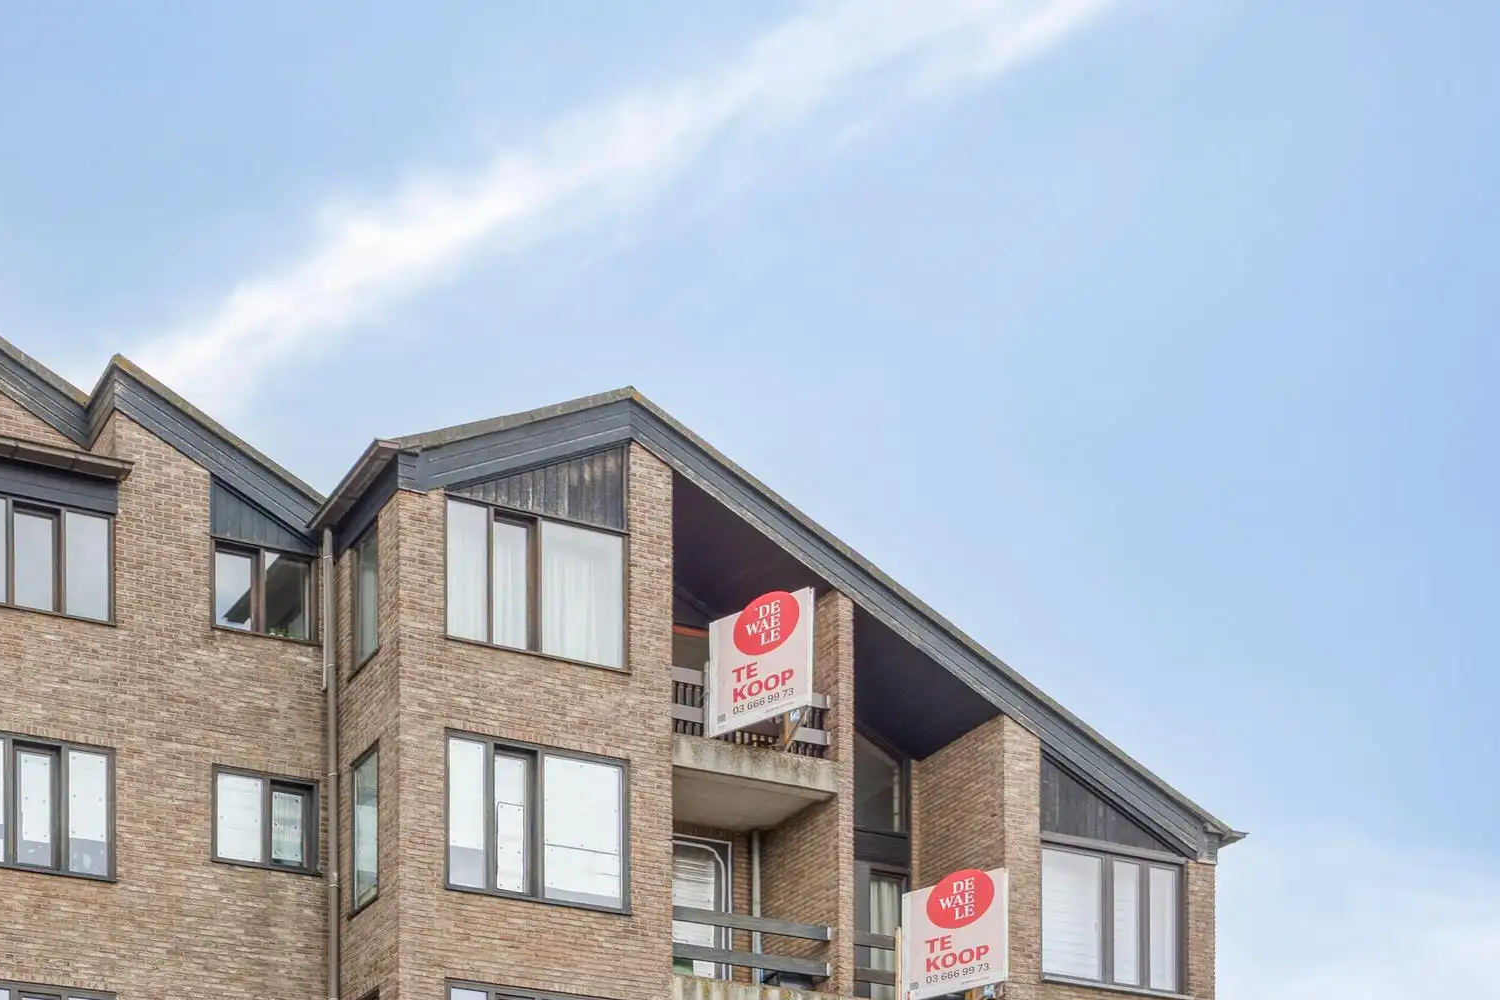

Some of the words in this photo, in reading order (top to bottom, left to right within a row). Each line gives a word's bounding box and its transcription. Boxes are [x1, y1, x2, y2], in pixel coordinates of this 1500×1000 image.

[758, 600, 781, 619] DE
[745, 614, 781, 636] WAE
[760, 628, 781, 646] LE
[732, 661, 758, 683] TE
[732, 668, 794, 703] KOOP
[732, 705, 745, 715] 03
[747, 698, 766, 711] 666
[767, 692, 780, 703] 99
[782, 688, 794, 698] 73
[952, 877, 975, 894] DE
[939, 890, 975, 910] WAE
[954, 904, 975, 920] LE
[925, 935, 952, 954] TE
[926, 945, 990, 973] KOOP
[925, 974, 938, 984] 03
[941, 969, 960, 981] 666
[962, 966, 975, 976] 99
[977, 962, 990, 972] 73
